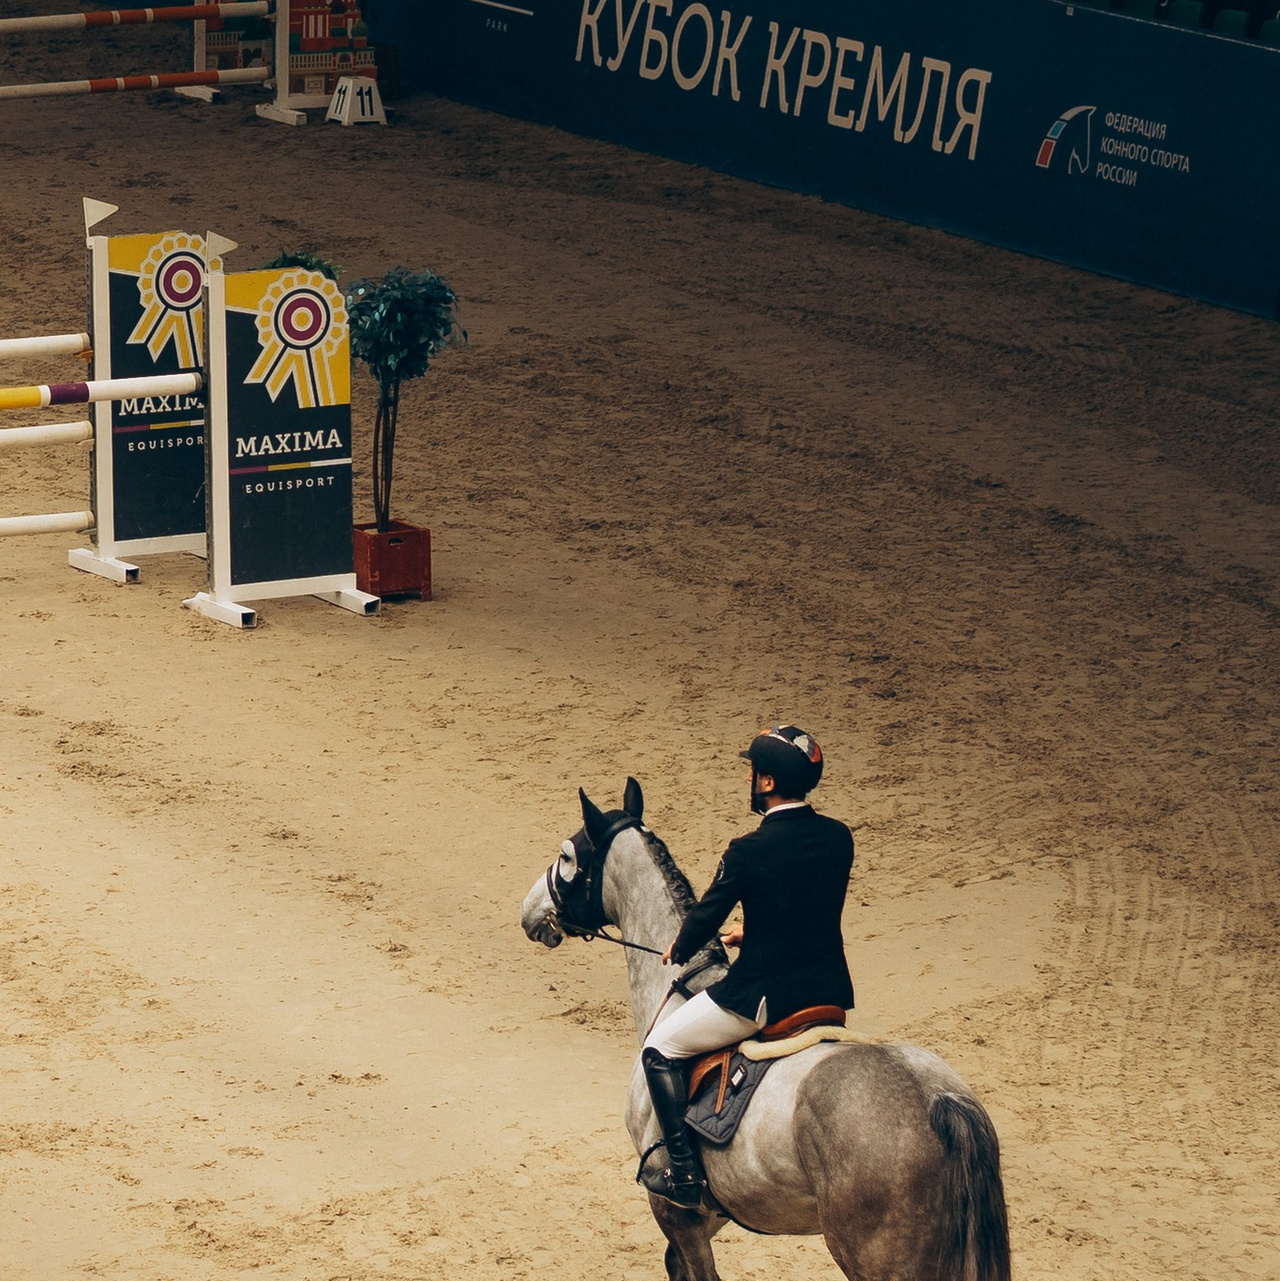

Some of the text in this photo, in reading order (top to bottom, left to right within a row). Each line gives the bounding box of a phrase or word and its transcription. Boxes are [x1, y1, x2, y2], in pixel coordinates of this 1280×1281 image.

[486, 18, 508, 33] PARK
[356, 85, 374, 117] 11
[759, 20, 993, 161] КРЕМЛЯ
[1105, 112, 1167, 140] ФЕДЕРАЦИЯ
[1100, 136, 1190, 174] КОННОГО СПОРТА
[1096, 161, 1138, 187] РОССИИ
[235, 428, 343, 458] MAXIMA
[245, 476, 335, 494] EQUISPORT
